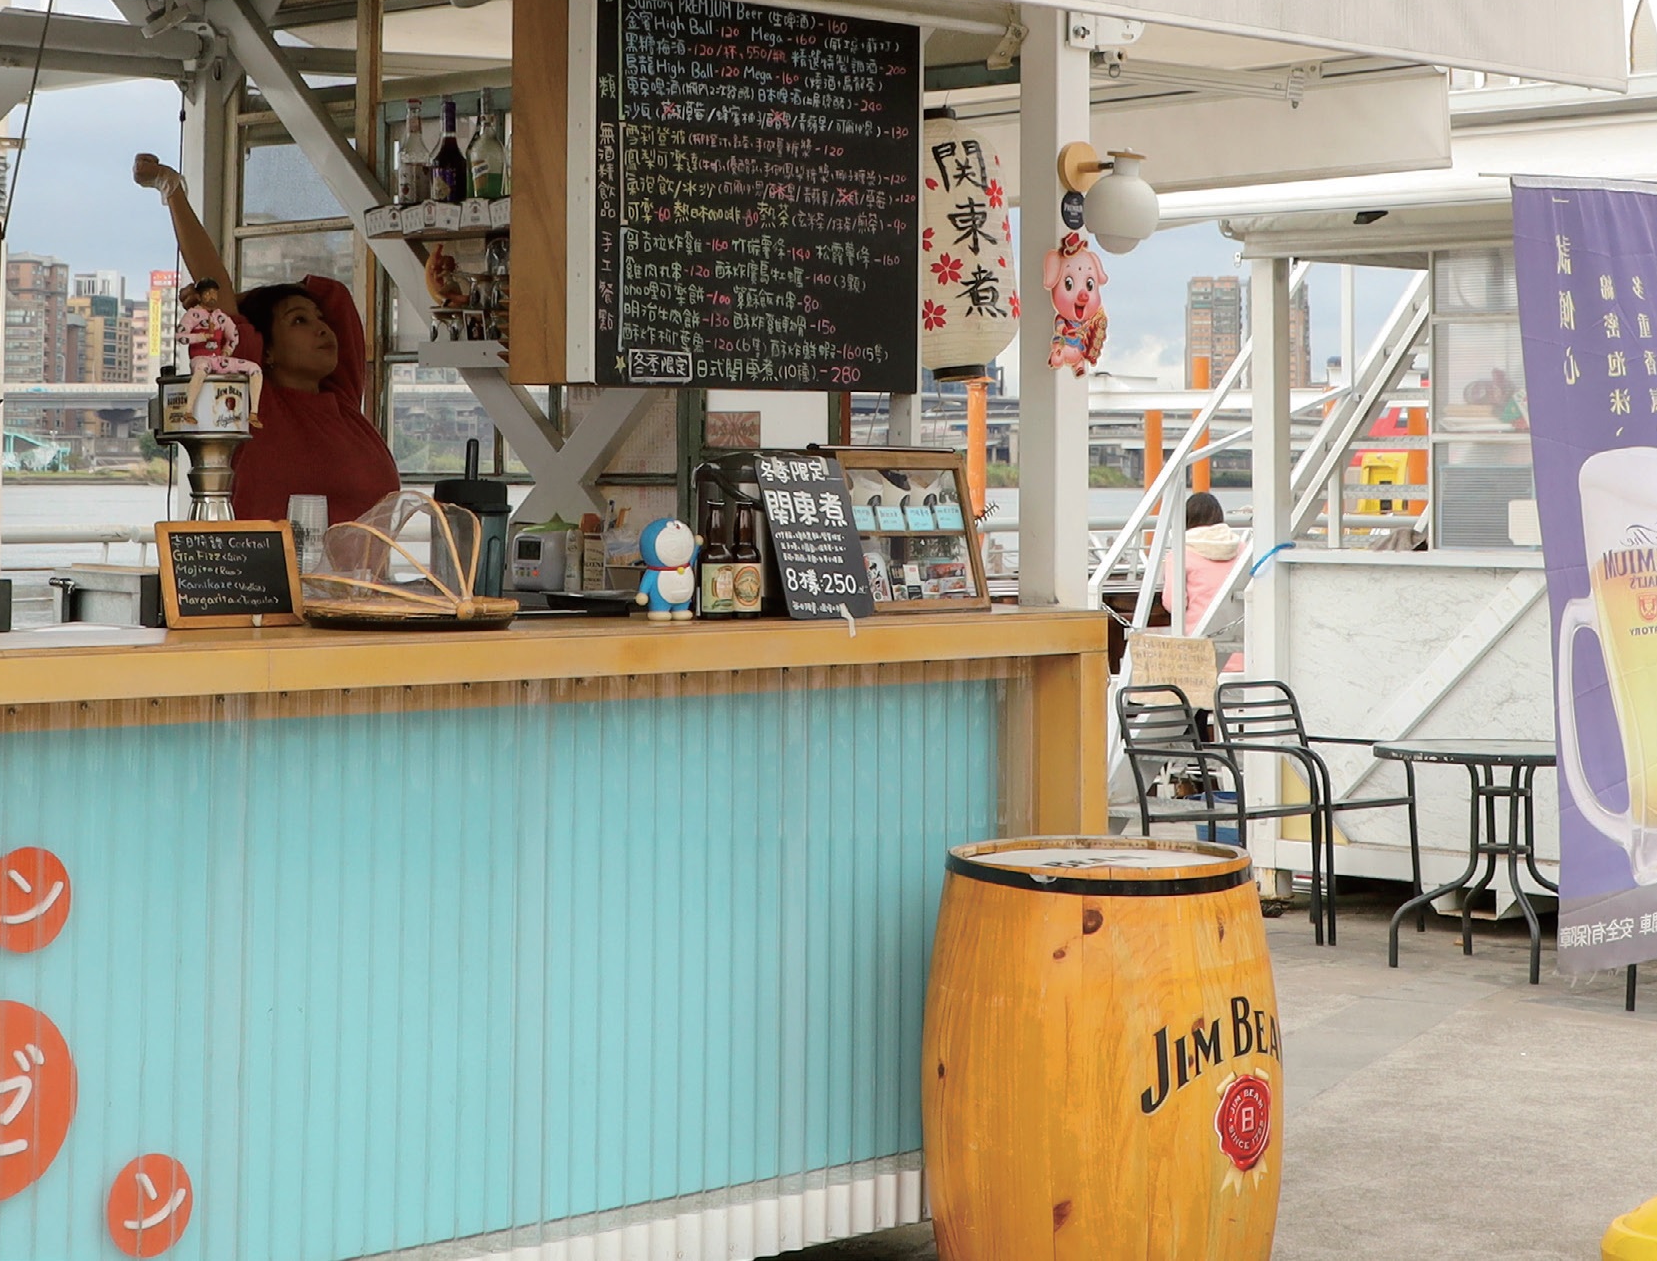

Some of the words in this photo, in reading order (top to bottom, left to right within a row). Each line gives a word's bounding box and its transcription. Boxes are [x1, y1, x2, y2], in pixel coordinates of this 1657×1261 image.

[736, 1, 763, 20] Beer
[689, 17, 713, 35] Ball
[751, 26, 783, 47] Mega
[691, 60, 714, 78] Ball
[744, 65, 773, 85] Mega
[1140, 1018, 1223, 1116] JIM
